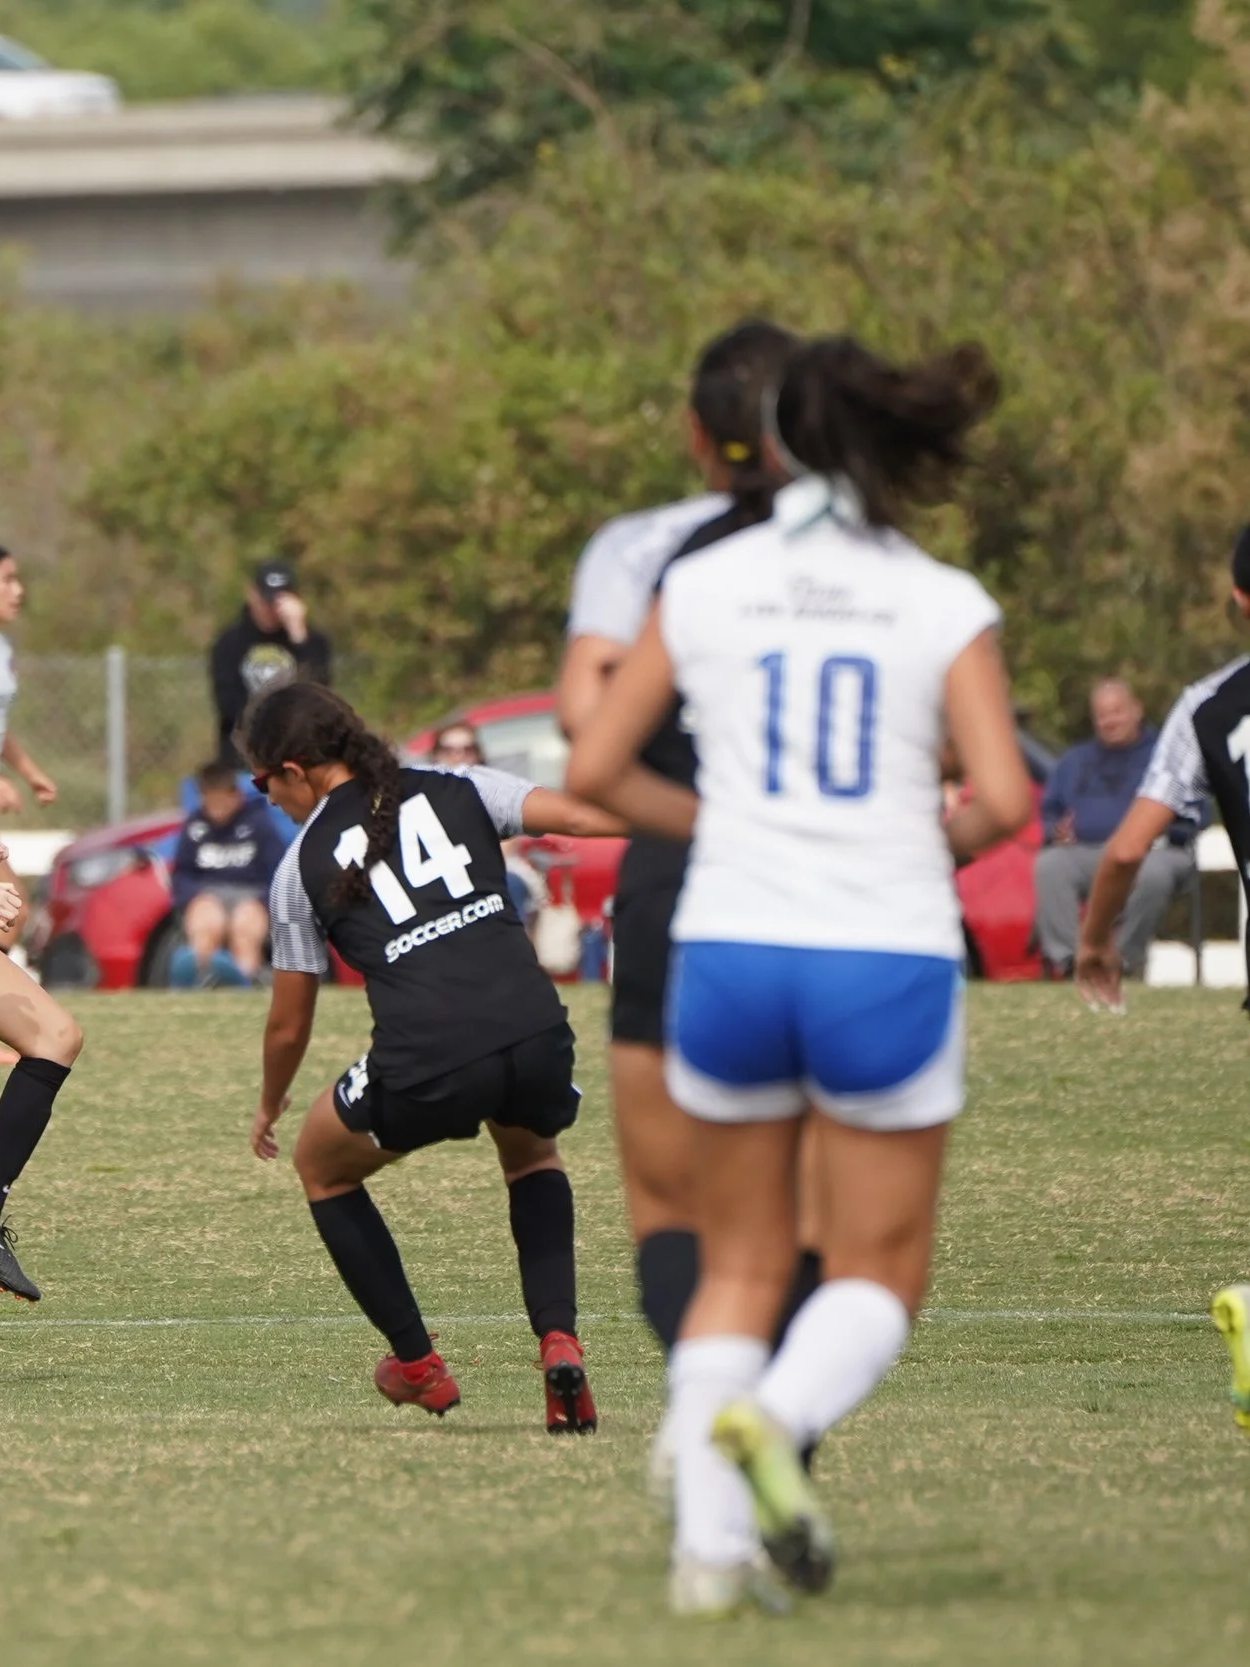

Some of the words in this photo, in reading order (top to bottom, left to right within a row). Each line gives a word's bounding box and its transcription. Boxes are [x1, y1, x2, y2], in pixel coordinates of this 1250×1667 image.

[758, 653, 876, 797] 10
[333, 792, 475, 926] 14
[384, 893, 504, 963] SOCCER.COM
